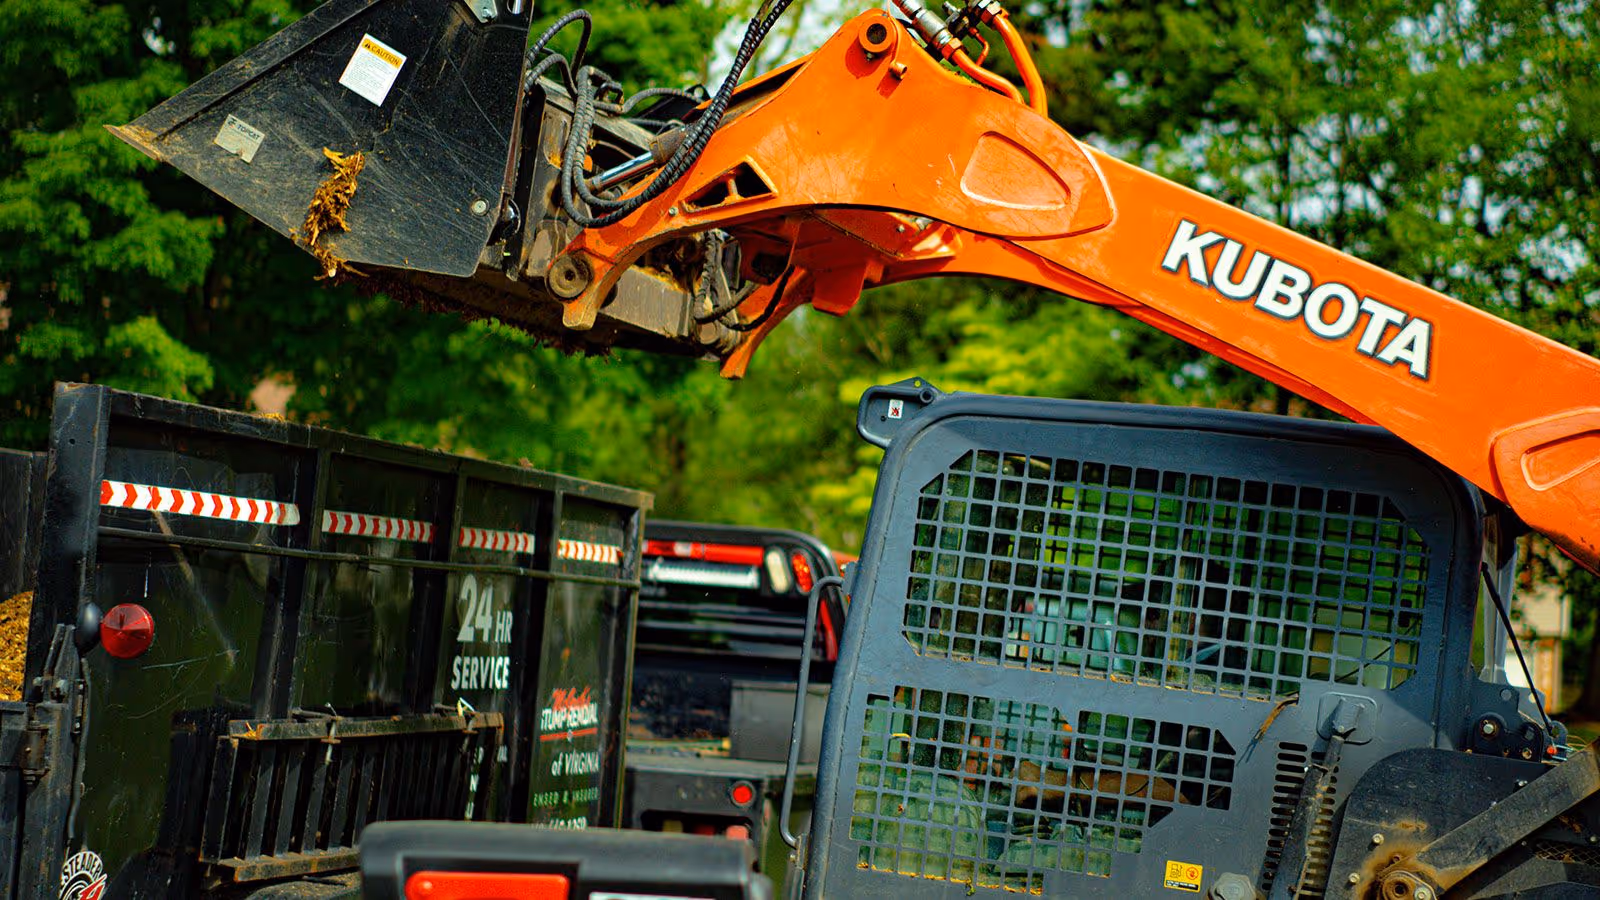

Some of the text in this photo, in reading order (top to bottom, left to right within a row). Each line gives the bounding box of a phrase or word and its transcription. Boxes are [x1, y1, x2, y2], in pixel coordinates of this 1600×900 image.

[371, 45, 400, 66] CAUTION
[1160, 218, 1432, 380] KUBOTA
[456, 573, 513, 643] 24 HR
[451, 655, 511, 690] SERVICE
[551, 748, 599, 776] of VIRGINIA
